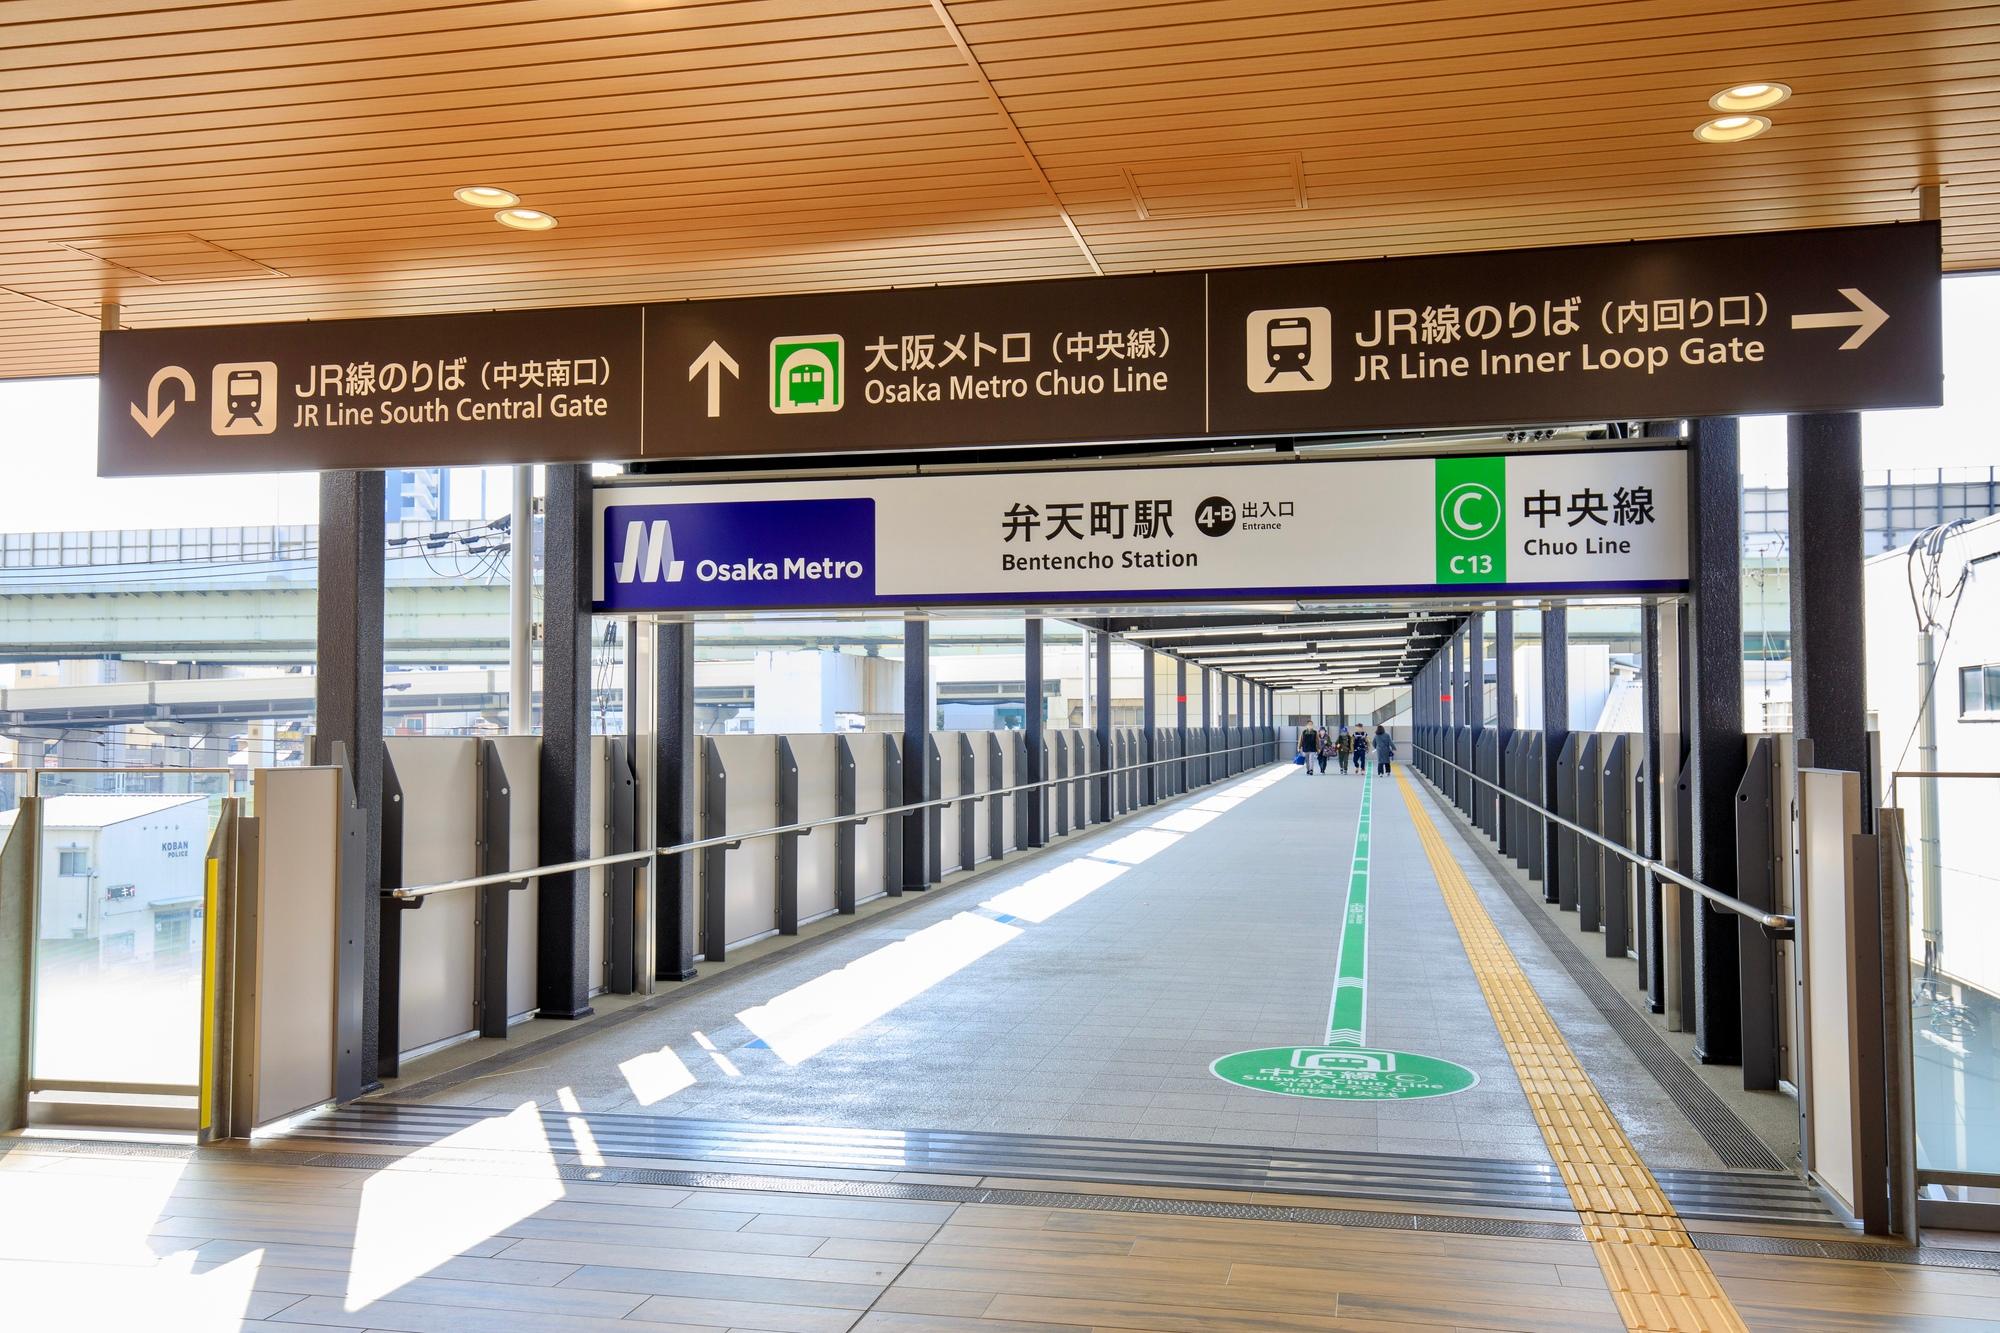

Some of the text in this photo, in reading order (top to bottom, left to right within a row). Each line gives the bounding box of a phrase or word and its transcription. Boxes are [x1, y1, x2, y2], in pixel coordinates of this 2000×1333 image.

[1355, 338, 1765, 381] JR Line Inner Loop Gate
[865, 367, 1167, 403] Osaka Metro Chuo Line
[294, 394, 607, 427] JR Line South Central Gate
[1198, 505, 1234, 528] 4-B
[1243, 502, 1293, 518] 出入口
[1524, 486, 1655, 528] 中央線
[1002, 500, 1173, 542] 弁天町駅
[1524, 537, 1630, 555] Chuo Line
[697, 558, 862, 581] Osaka Metro
[1003, 550, 1197, 570] Bentencho Station
[162, 841, 189, 851] KOBAN
[1242, 1074, 1324, 1084] Subway
[1260, 1068, 1378, 1080] 中央線
